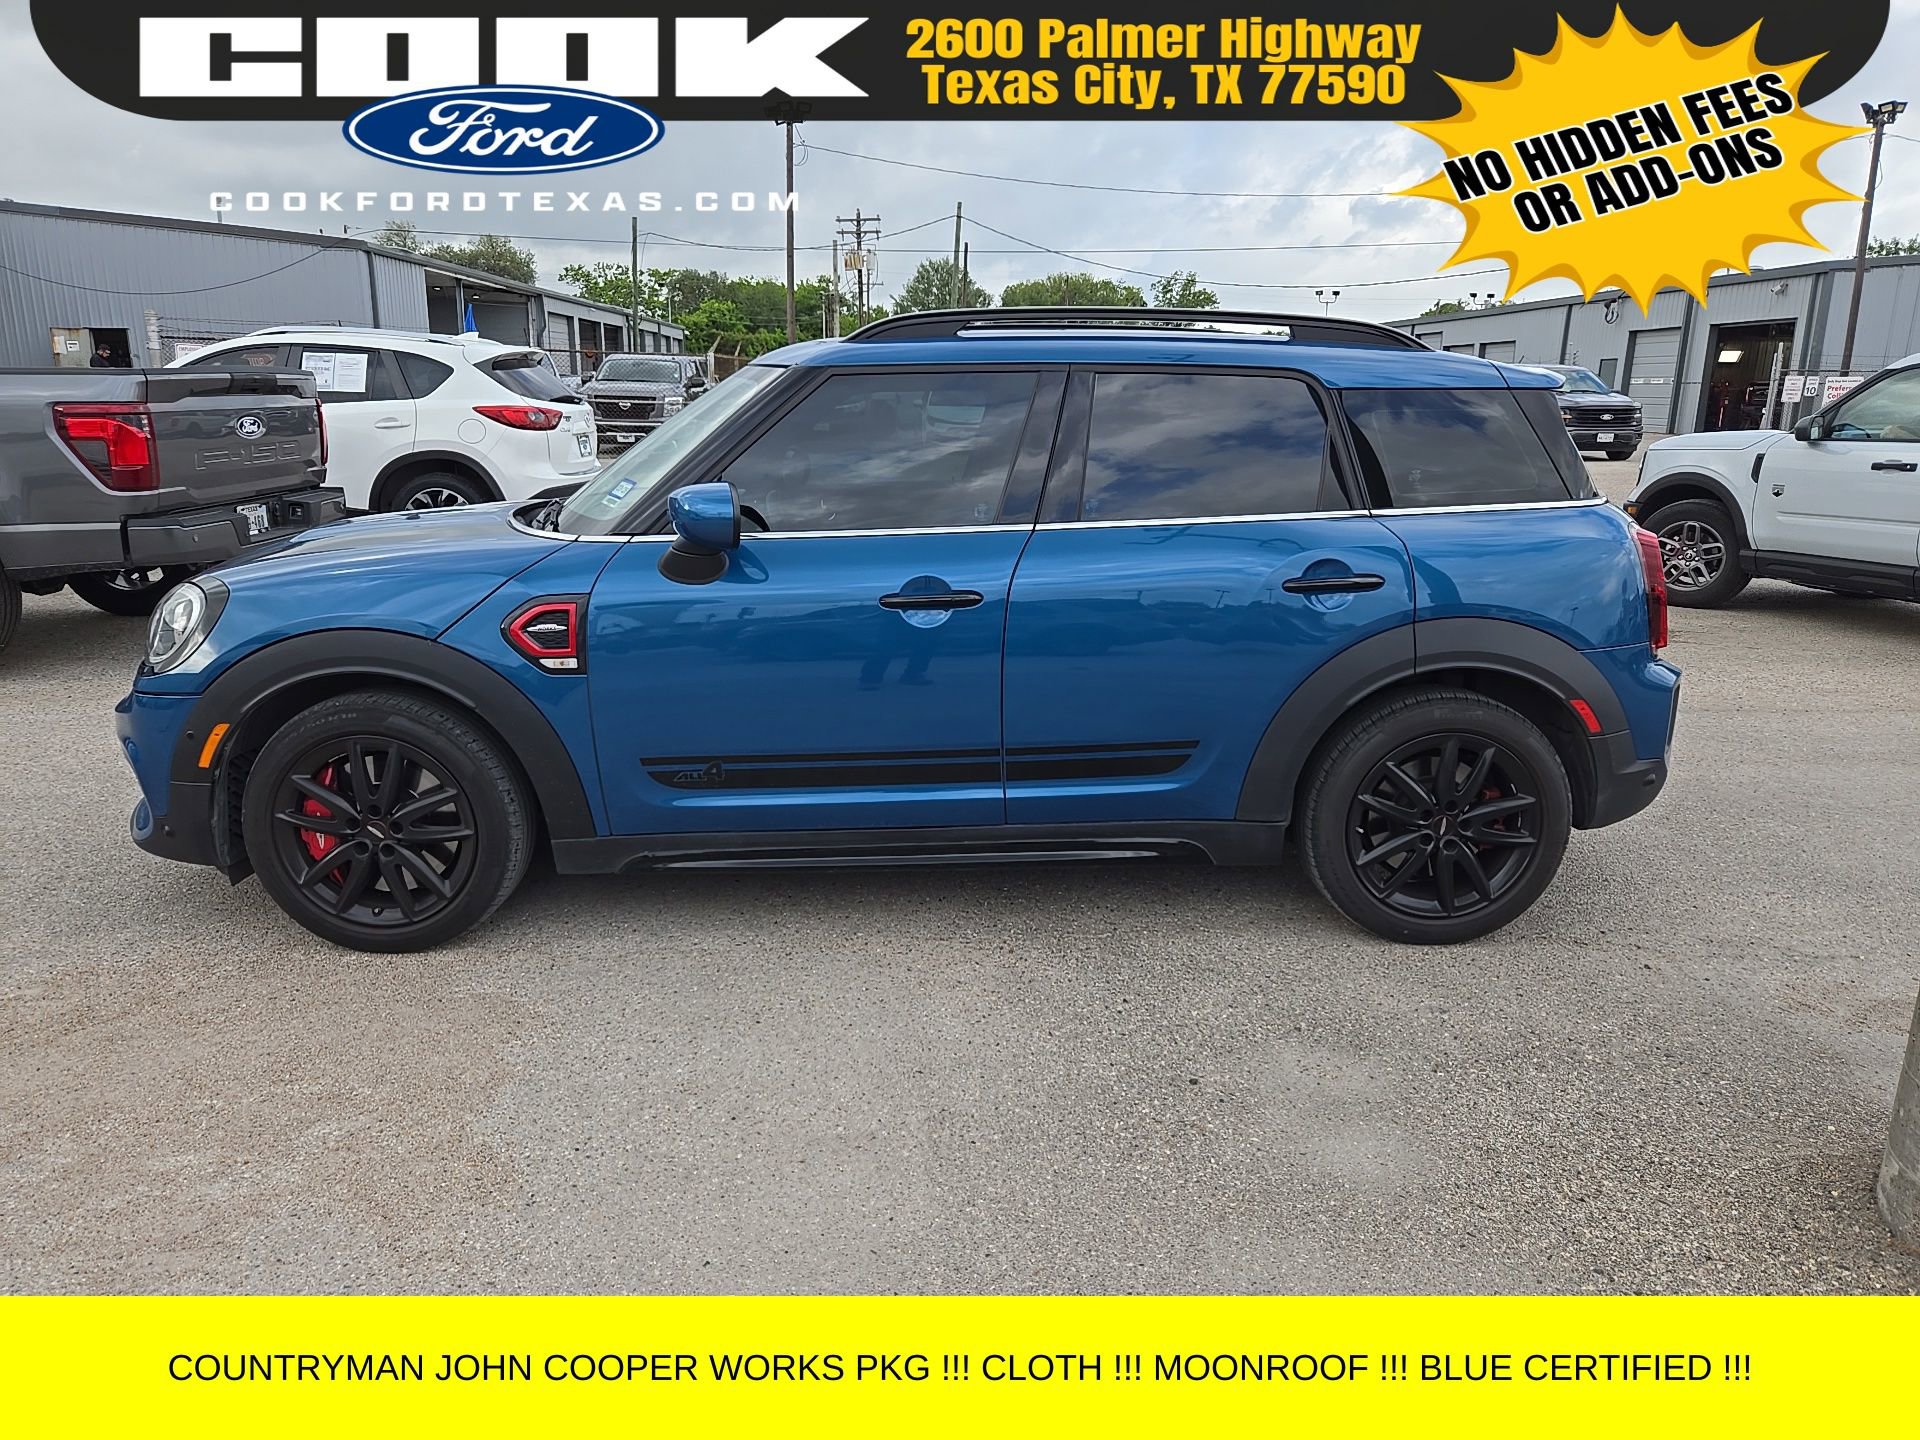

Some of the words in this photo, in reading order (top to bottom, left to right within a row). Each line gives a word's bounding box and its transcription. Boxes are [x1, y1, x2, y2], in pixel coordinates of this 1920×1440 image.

[1806, 387, 1816, 395] 10
[242, 420, 258, 432] Ford
[195, 440, 303, 470] F-150
